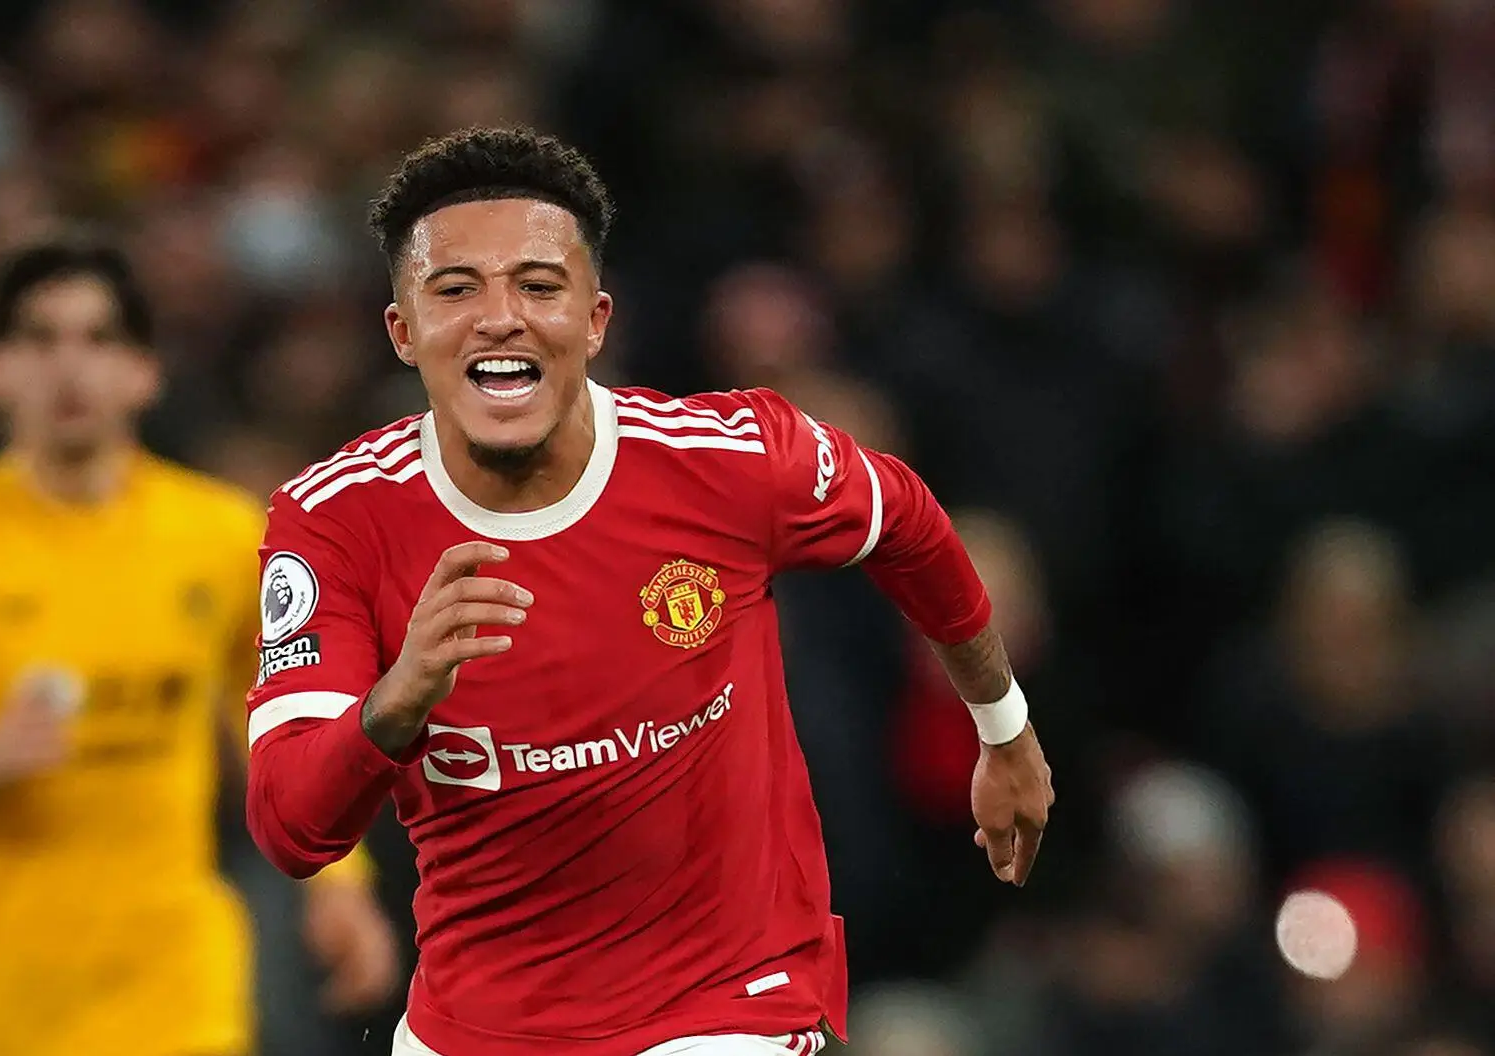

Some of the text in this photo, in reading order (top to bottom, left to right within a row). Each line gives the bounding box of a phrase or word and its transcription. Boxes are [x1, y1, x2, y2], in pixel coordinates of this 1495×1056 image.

[647, 566, 713, 603] MANCHESTER
[669, 620, 714, 643] UNITED
[500, 682, 734, 773] TeamViewer
